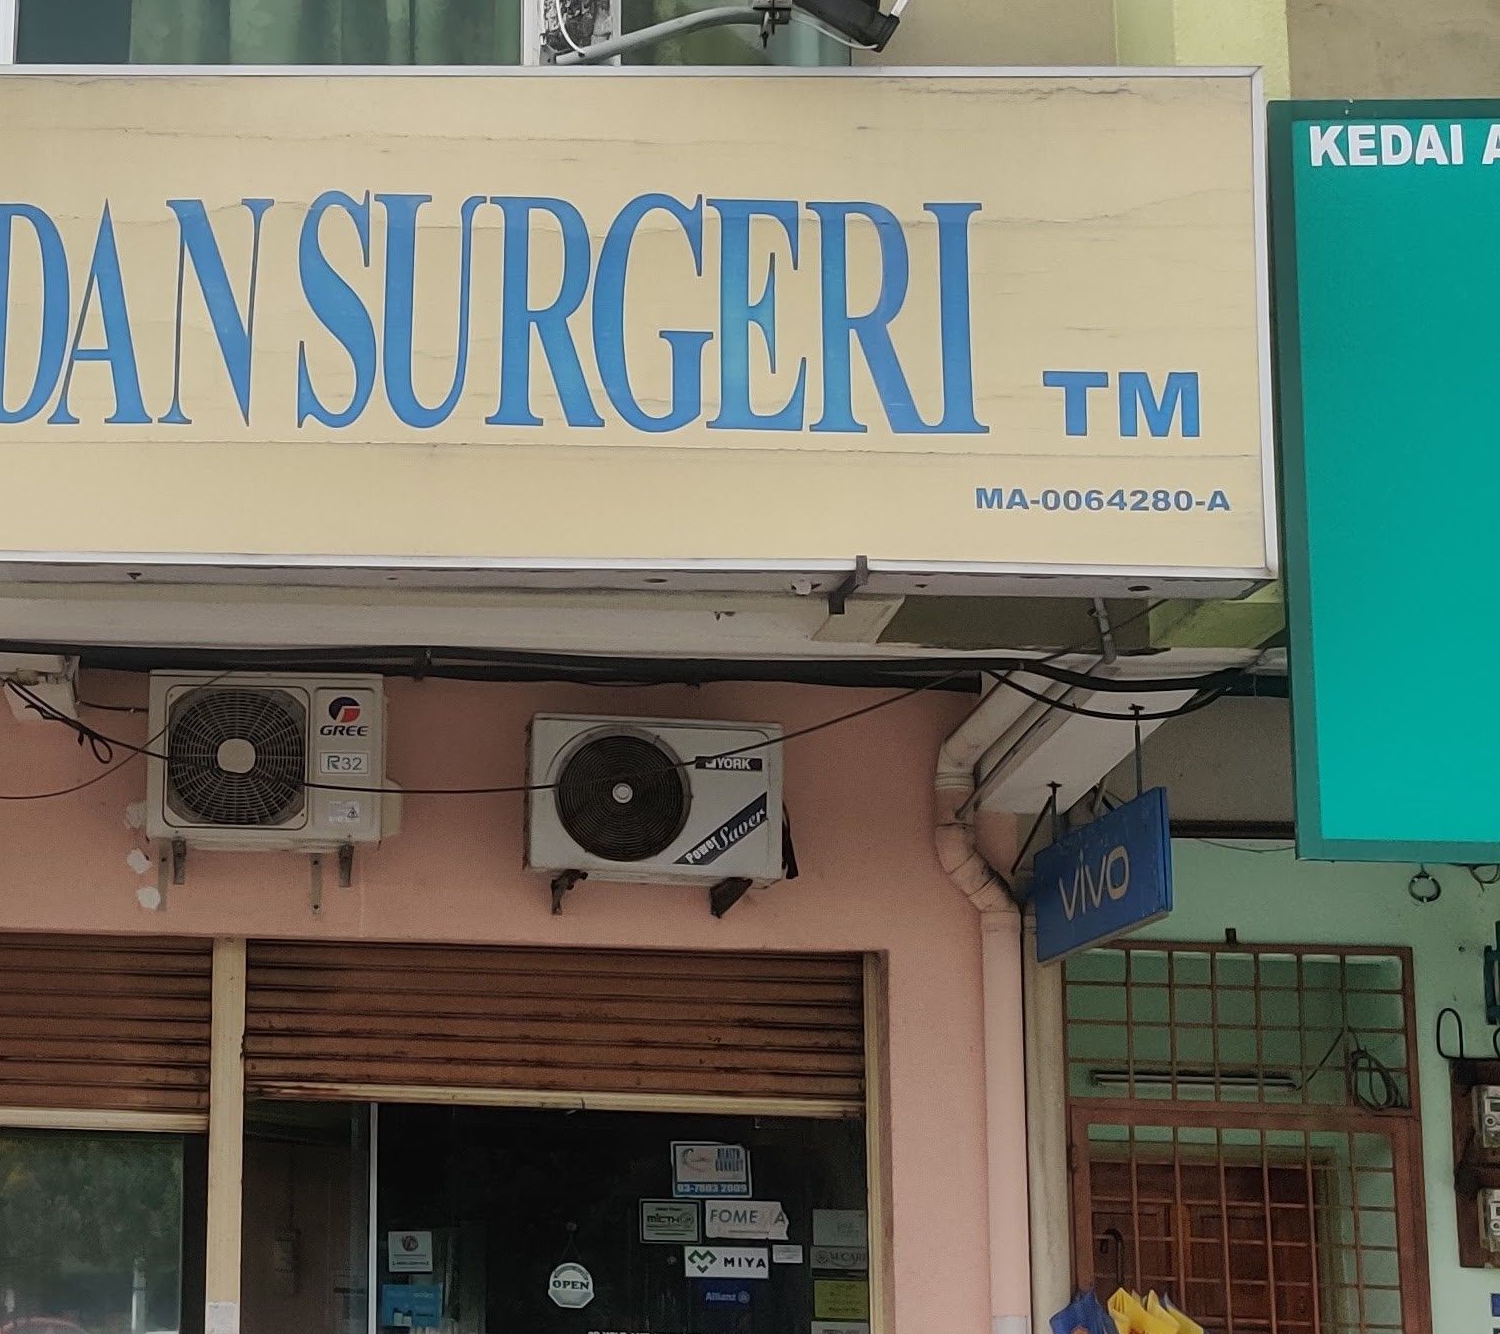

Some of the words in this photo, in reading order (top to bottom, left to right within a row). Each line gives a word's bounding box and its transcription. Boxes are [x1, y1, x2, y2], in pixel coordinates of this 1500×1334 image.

[1310, 124, 1464, 167] KEDAI
[298, 189, 990, 434] SURGERI
[1042, 370, 1200, 437] TM
[975, 487, 1230, 512] MA-0064280-A
[319, 725, 369, 736] GREE
[326, 755, 362, 771] R32
[716, 757, 751, 770] YORK
[719, 808, 765, 847] Saver
[723, 1256, 767, 1269] MIYA
[552, 1280, 590, 1290] OPEN
